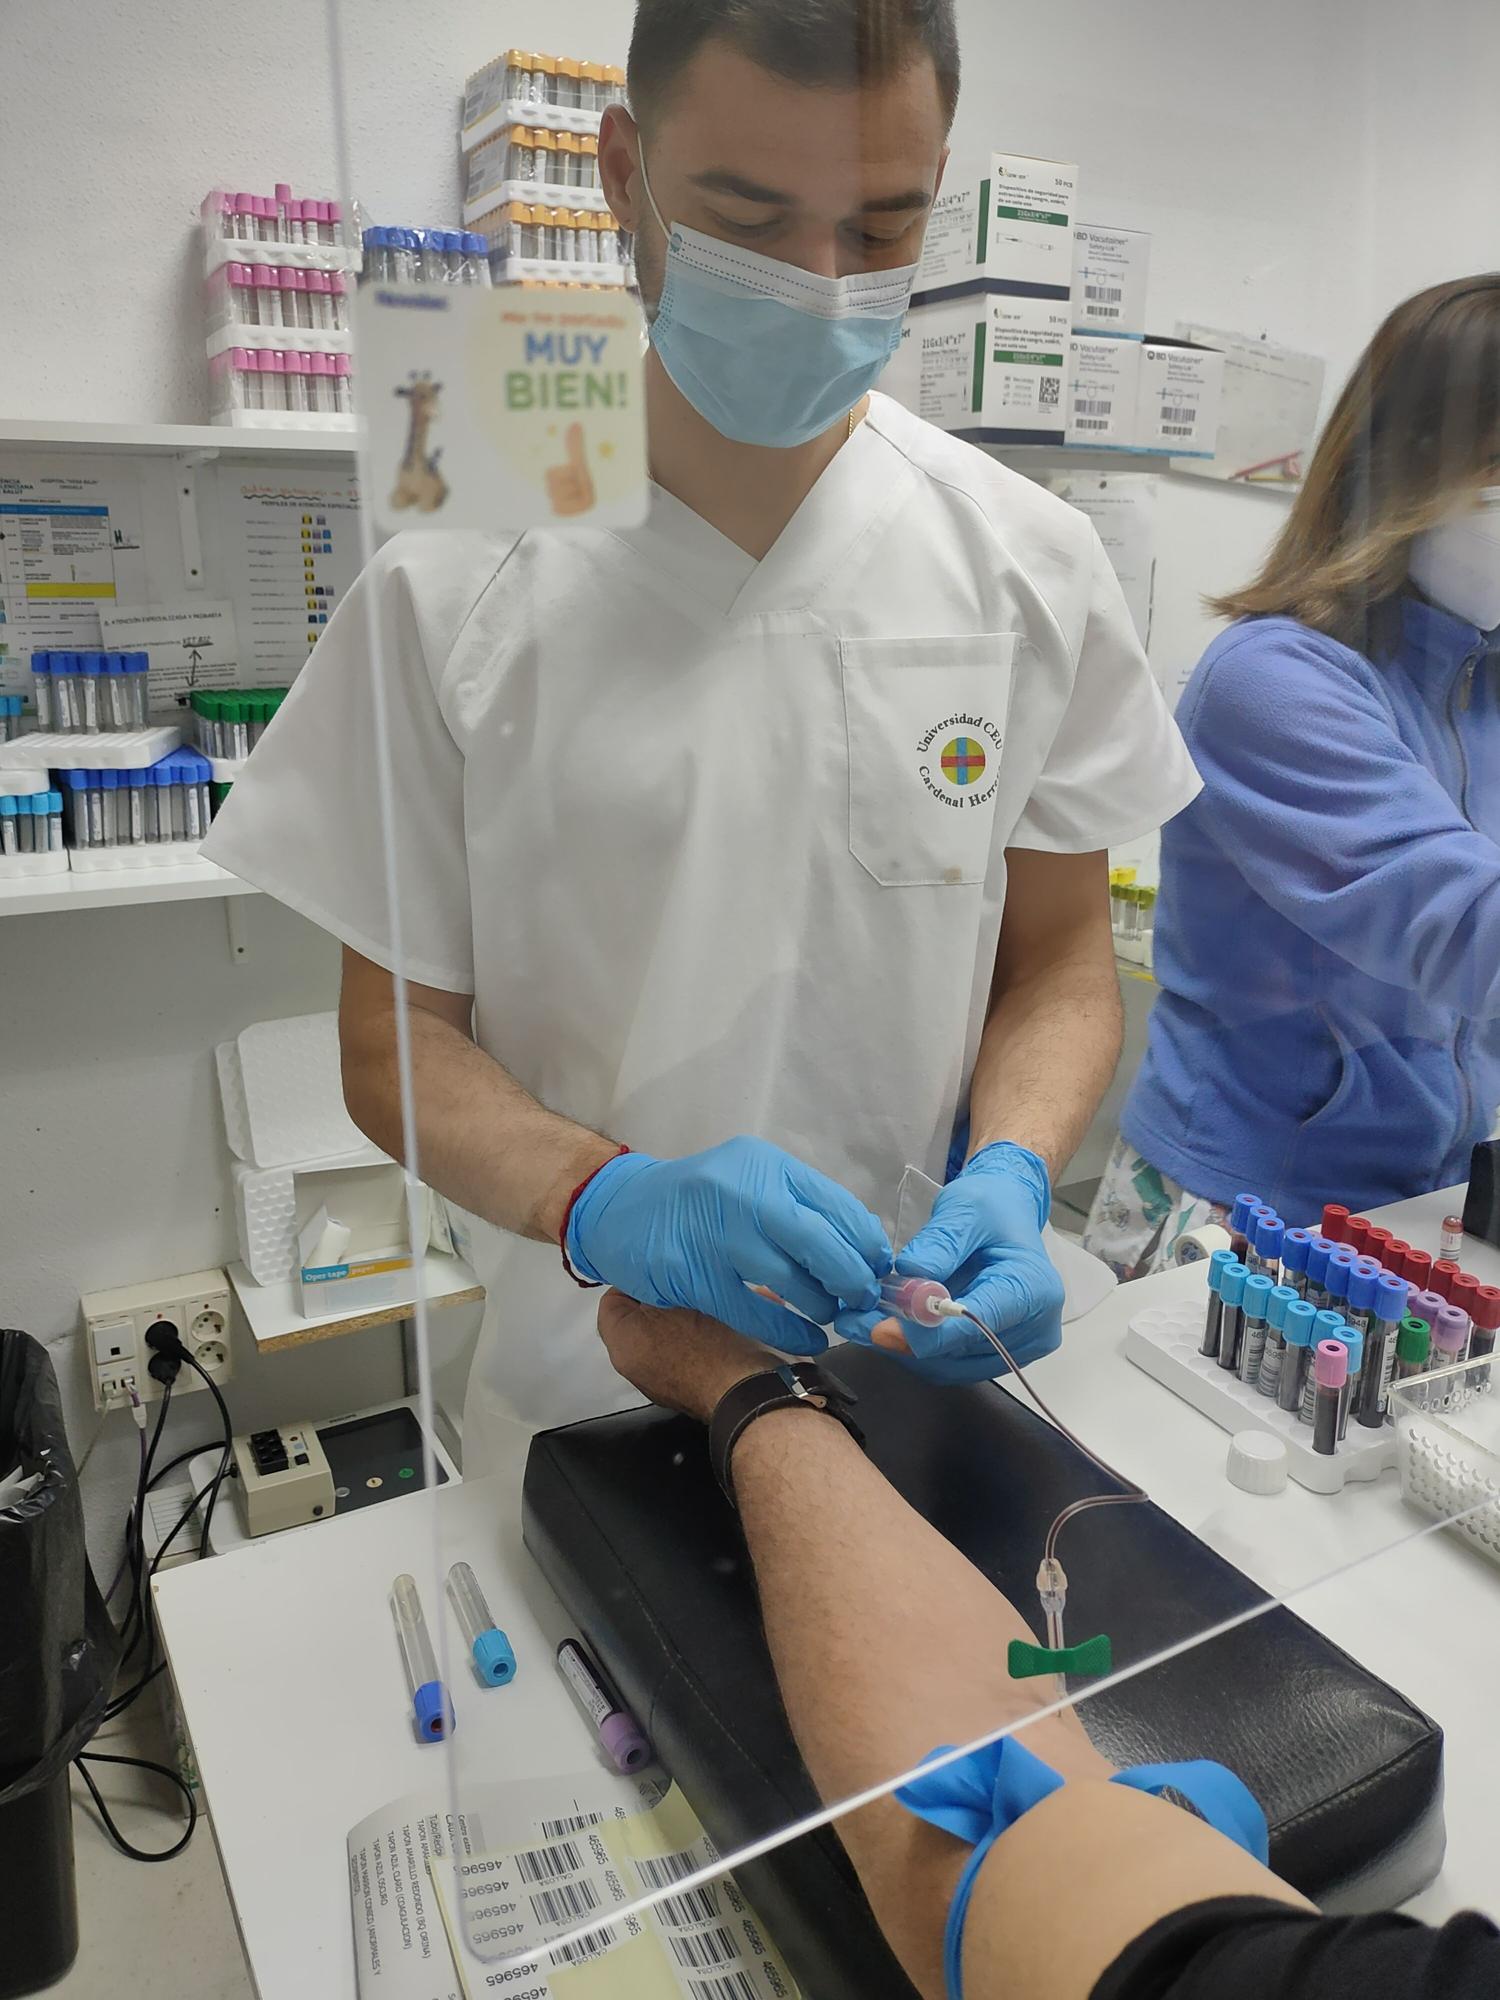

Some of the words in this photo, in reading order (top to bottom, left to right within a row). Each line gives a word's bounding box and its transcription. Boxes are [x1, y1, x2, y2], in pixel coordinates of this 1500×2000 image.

[1076, 232, 1088, 241] BD
[524, 331, 609, 365] MUY
[504, 370, 628, 411] BIEN!
[917, 713, 984, 753] Universidad
[984, 722, 1003, 750] CEU
[919, 766, 964, 808] Cardenal
[968, 766, 1001, 808] Herr
[387, 1830, 396, 1854] TAPON
[402, 1824, 412, 1847] TAPON
[416, 1818, 427, 1842] TAPON
[390, 1853, 399, 1872] AZUL
[406, 1847, 418, 1880] AMARILLO
[588, 1834, 609, 1865] 465965
[372, 1837, 382, 1860] TAPON
[378, 1877, 389, 1906] OSCURO
[393, 1871, 403, 1894] CLARO
[604, 1870, 626, 1902] 465965
[412, 1880, 424, 1916] REDONDO
[470, 1902, 517, 1921] 46596
[722, 1880, 746, 1914] 465965
[472, 1923, 525, 1945] 465965
[624, 1912, 642, 1936] 5965
[742, 1919, 767, 1956] 465965
[420, 1931, 431, 1959] ORINA)
[570, 1948, 608, 1967] CALLOSA
[486, 1963, 539, 1987] 465965
[762, 1960, 789, 1999] 465965
